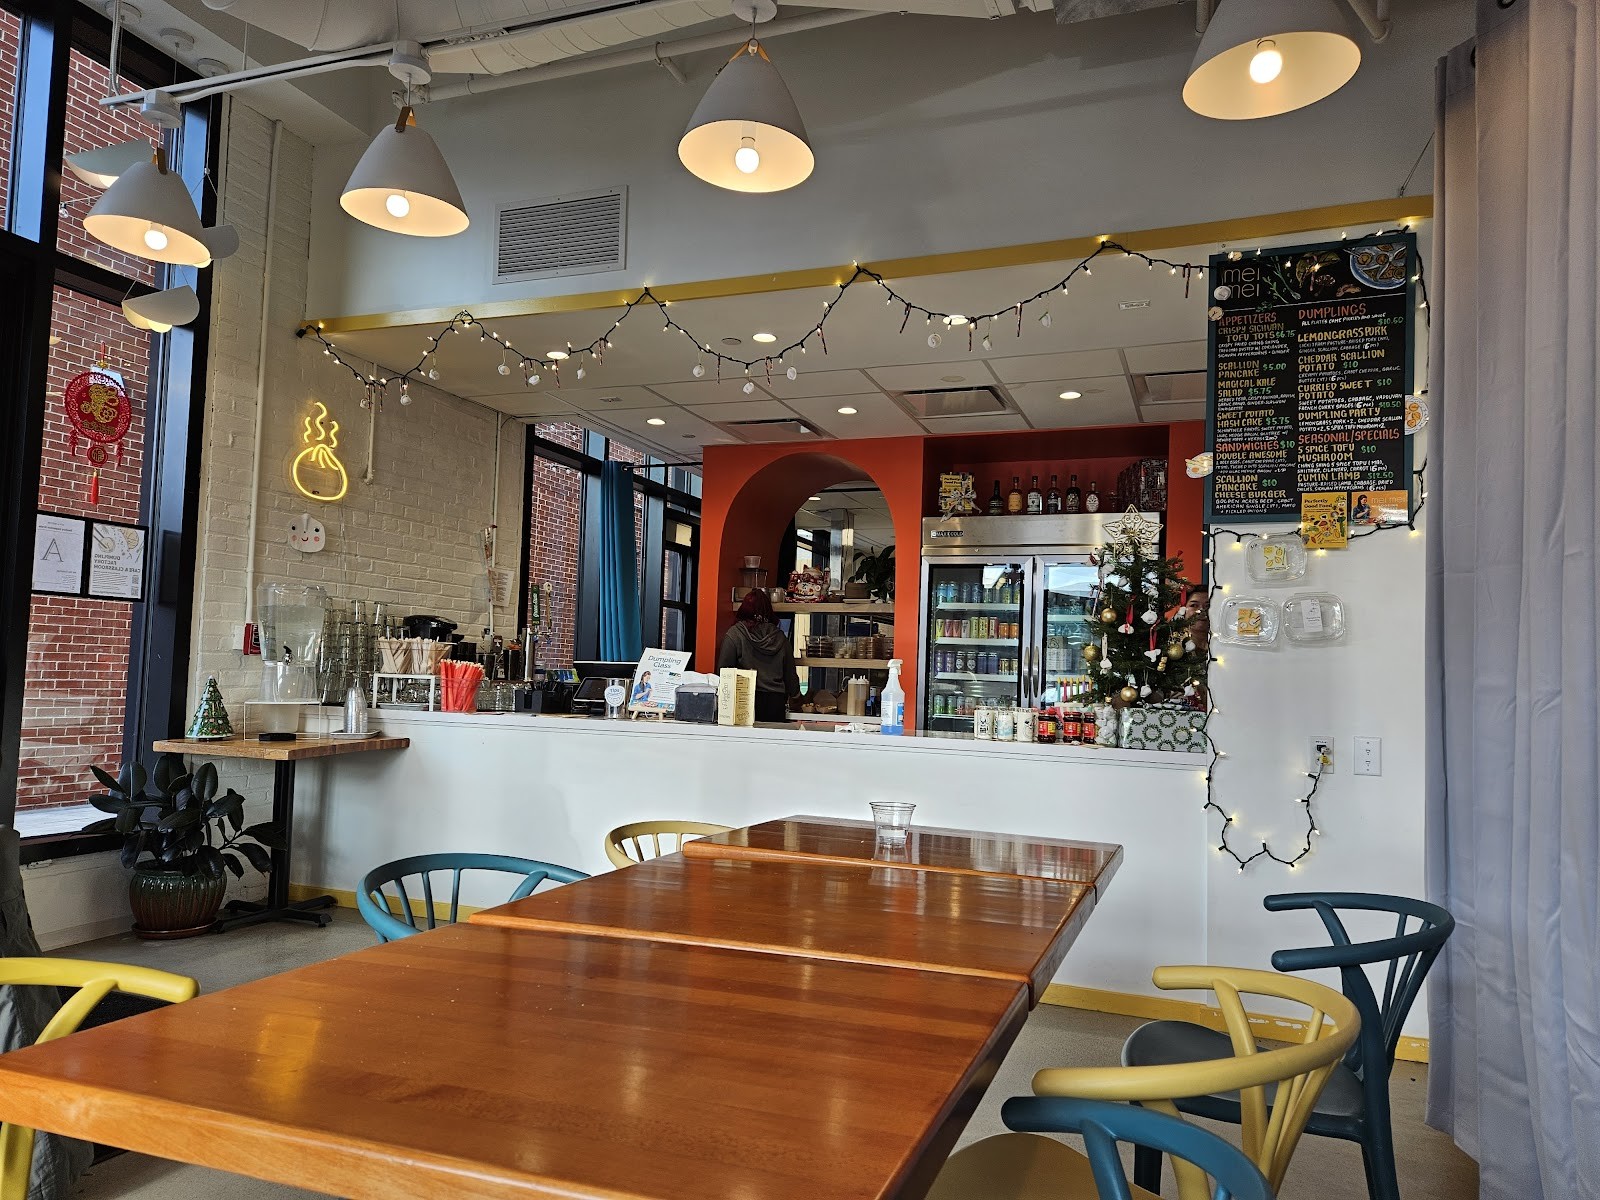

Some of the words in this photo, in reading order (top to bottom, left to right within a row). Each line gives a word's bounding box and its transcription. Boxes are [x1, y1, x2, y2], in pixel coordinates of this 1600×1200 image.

[1223, 268, 1260, 284] mei
[1298, 302, 1367, 320] DUMPLINGS
[1218, 312, 1277, 327] APPETIZERS
[1218, 326, 1246, 335] CRISPY
[1248, 322, 1284, 333] SICHUAN
[1298, 327, 1364, 342] LEMONGRASS
[1364, 326, 1388, 336] PORK
[1225, 333, 1250, 342] TOFU
[1252, 330, 1276, 341] TOTS
[1276, 330, 1296, 338] $6.75
[1298, 353, 1338, 364] CHEDDAR
[1340, 348, 1385, 361] SCALLION
[1218, 360, 1260, 370] SCALLION
[1262, 362, 1287, 370] $5.00
[1298, 362, 1335, 372] POTATO
[1342, 360, 1358, 369] $10
[1218, 368, 1260, 378] PANCAKE
[1218, 379, 1255, 388] MAGICAL
[1256, 377, 1276, 387] KALE
[1298, 382, 1338, 392] CURRIED
[1340, 380, 1374, 390] SWEET
[1376, 378, 1392, 386] $10
[1218, 388, 1244, 398] SALAD
[1248, 386, 1272, 396] $5.75
[1298, 390, 1335, 400] POTATO
[1216, 411, 1245, 420] SWEET
[1245, 409, 1274, 418] POTATO
[1298, 409, 1348, 420] DUMPLING
[1348, 407, 1381, 418] PARTY
[1217, 419, 1240, 428] HASH
[1242, 418, 1264, 427] CAKE
[1266, 416, 1290, 426] $5.75
[1298, 428, 1400, 444] SEASONAL/SPECIALS
[1216, 440, 1280, 452] SANDWICHES
[1280, 440, 1296, 449] $10
[1298, 446, 1304, 454] 5
[1304, 444, 1330, 454] SPICE
[1331, 443, 1355, 452] TOFU
[1360, 445, 1376, 454] $10
[1216, 452, 1247, 460] DOUBLE
[1248, 449, 1288, 460] AWESOME
[1298, 452, 1354, 462] MUSHROOM
[1216, 474, 1258, 484] SCALLION
[1262, 478, 1278, 487] $10
[1298, 472, 1329, 482] CUMIN
[1331, 471, 1361, 481] LAMB
[1368, 471, 1394, 480] $12.50
[1216, 482, 1258, 492] PANCAKE
[1215, 491, 1247, 499] CHEESE
[1248, 490, 1287, 499] BURGER
[648, 655, 682, 666] Dumpling
